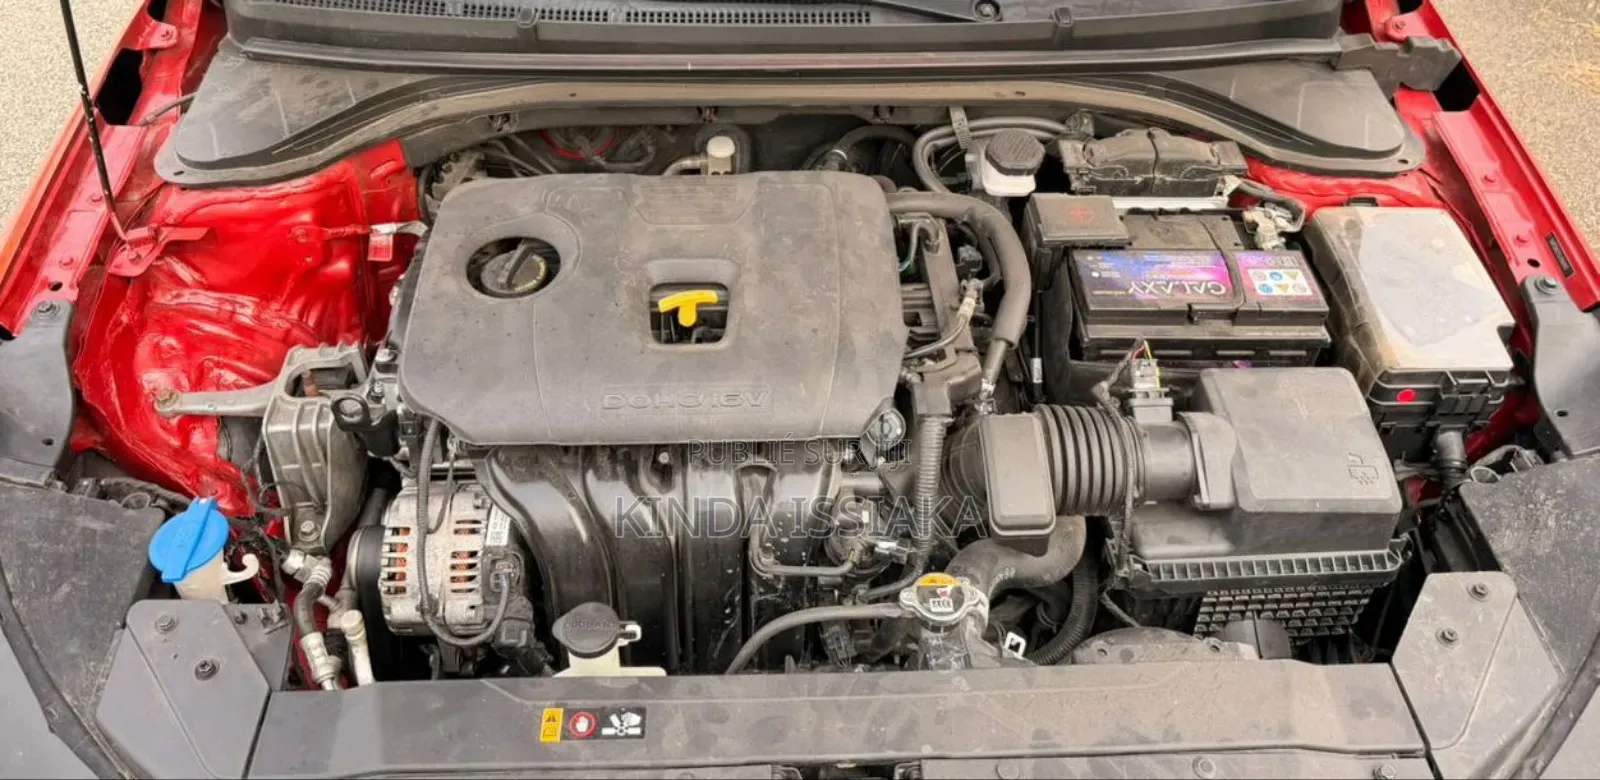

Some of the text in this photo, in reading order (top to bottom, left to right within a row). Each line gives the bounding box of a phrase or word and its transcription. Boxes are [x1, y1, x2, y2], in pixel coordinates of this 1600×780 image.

[1128, 280, 1227, 296] GALAXY
[602, 390, 770, 410] DOHC 16V
